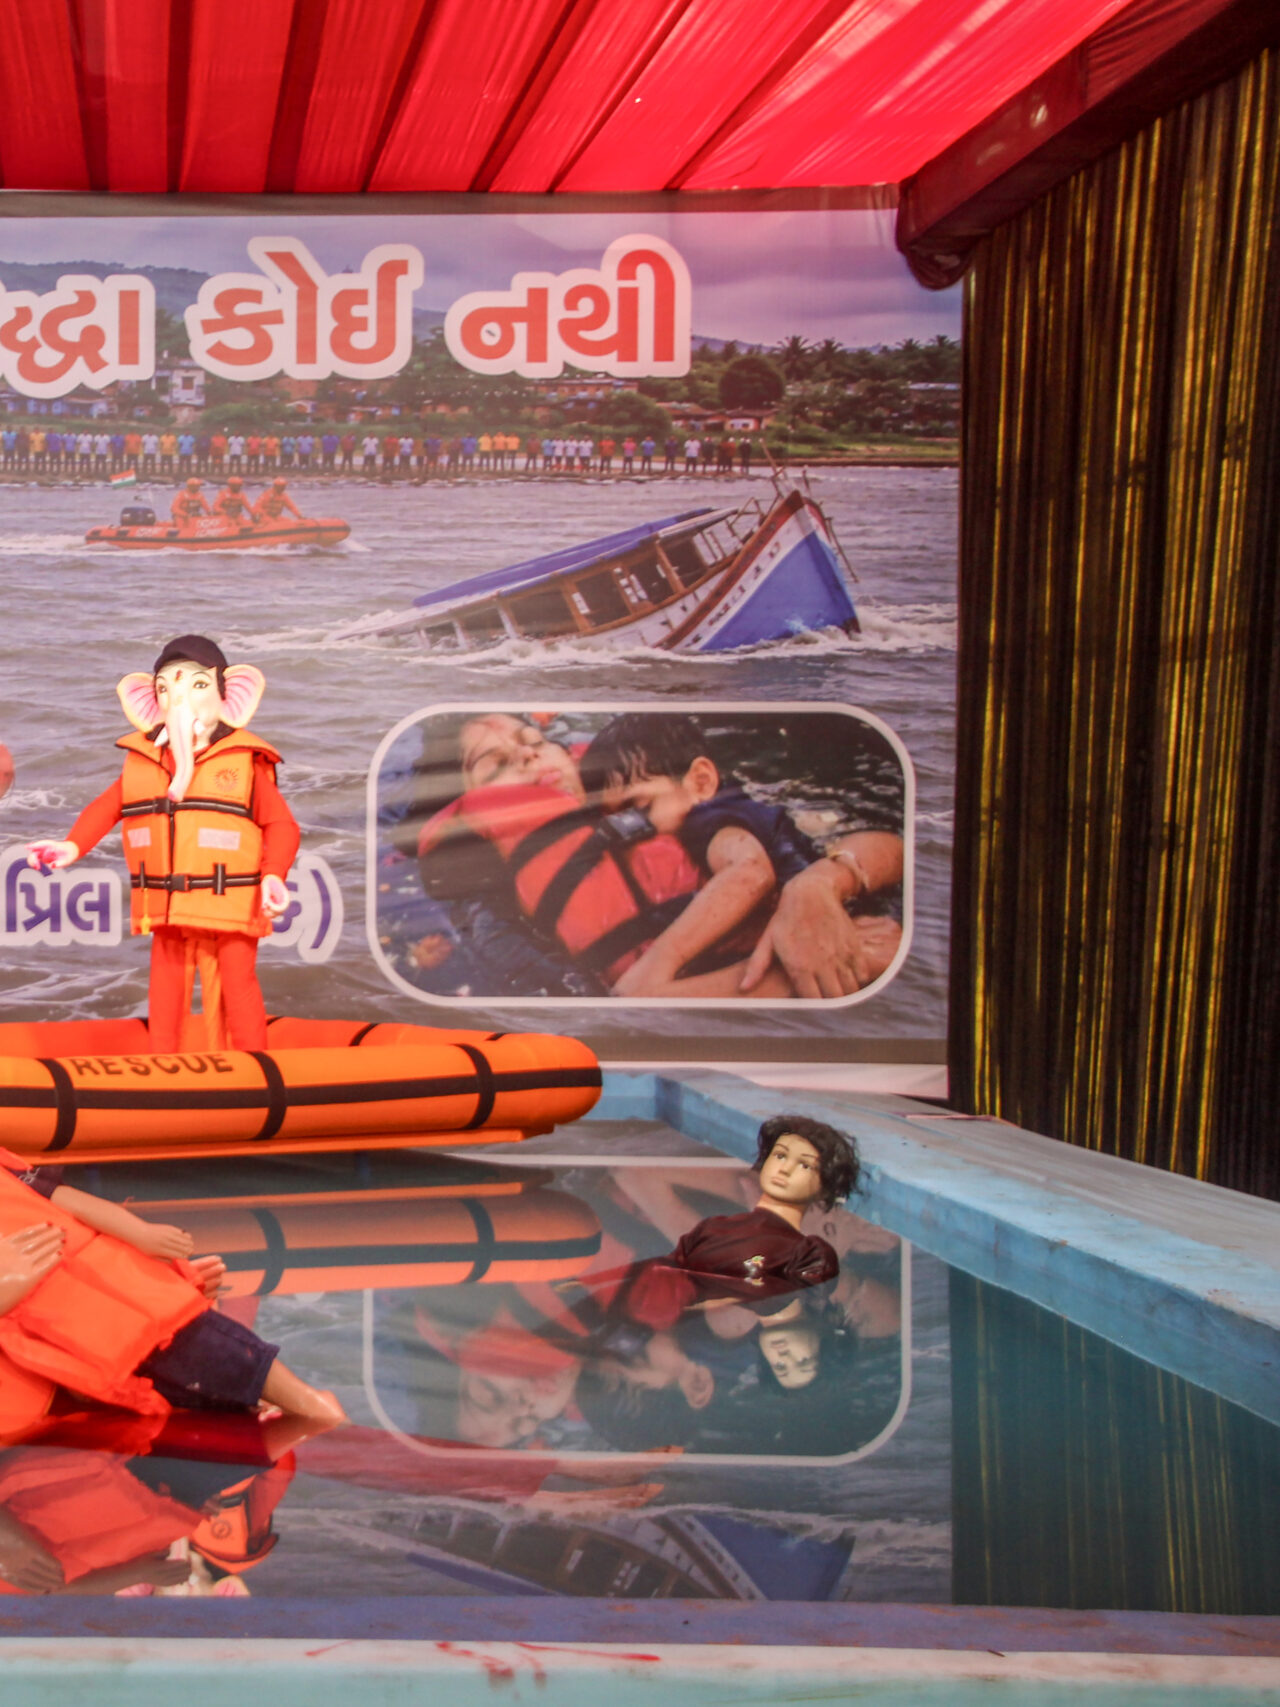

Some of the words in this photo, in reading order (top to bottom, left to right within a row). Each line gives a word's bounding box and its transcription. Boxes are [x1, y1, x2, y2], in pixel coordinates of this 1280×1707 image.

[196, 247, 413, 371] કોઈ
[455, 245, 680, 368] નથી
[73, 1050, 235, 1078] RESCUE
